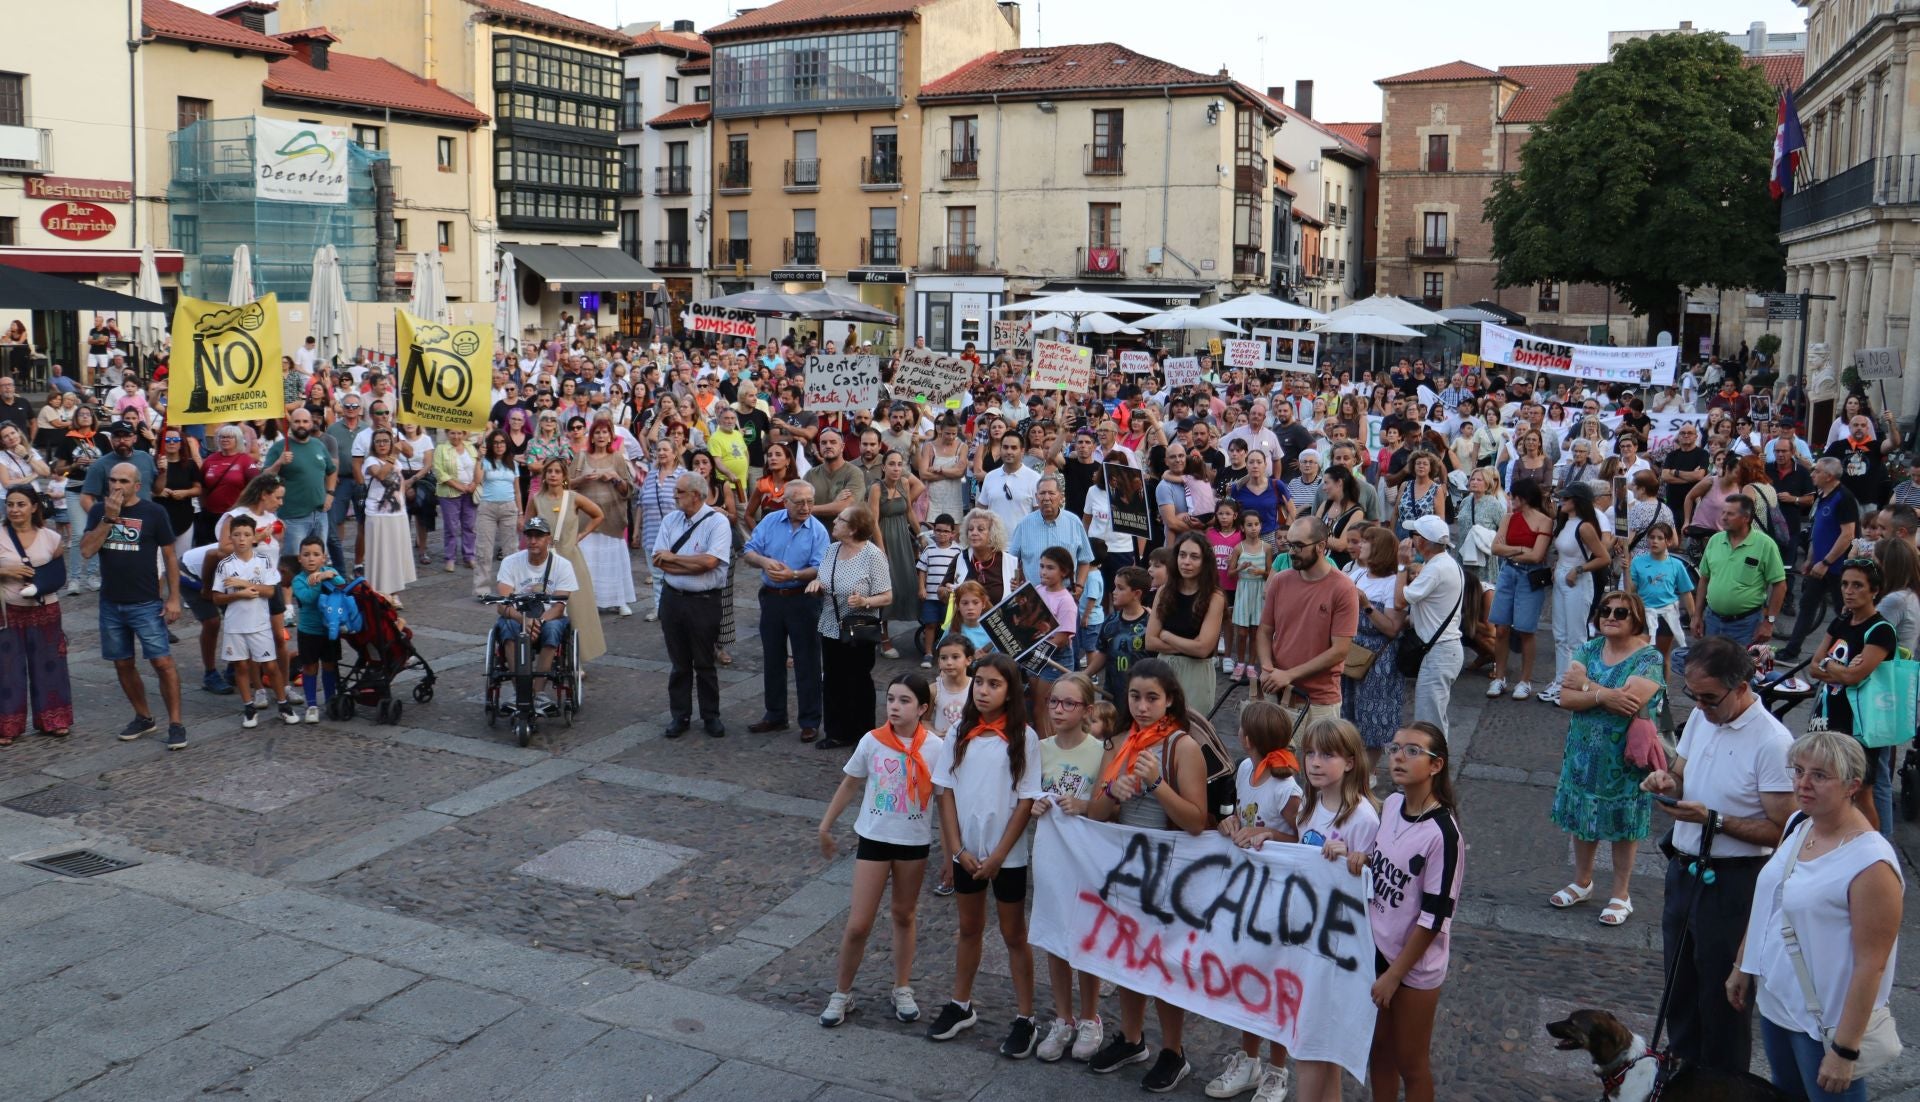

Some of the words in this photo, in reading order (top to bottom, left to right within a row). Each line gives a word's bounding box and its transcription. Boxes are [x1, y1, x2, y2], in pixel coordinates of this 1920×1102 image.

[29, 178, 131, 199] Restaurante
[66, 202, 94, 216] Bar
[61, 218, 115, 236] Capricho
[1513, 338, 1575, 359] ALCALDE
[810, 356, 858, 374] Puente
[1869, 351, 1890, 366] NO
[402, 347, 466, 405] NO
[832, 371, 879, 386] Castro
[808, 383, 827, 392] dice
[211, 390, 267, 404] INCINERADORA
[214, 403, 239, 413] PUENTE
[239, 401, 268, 410] CASTRO
[415, 400, 474, 417] INCINERADORA
[417, 410, 444, 422] PUENTE
[445, 416, 473, 425] CASTRO
[1117, 655, 1129, 672] 10
[1099, 831, 1366, 973] ALCALDE
